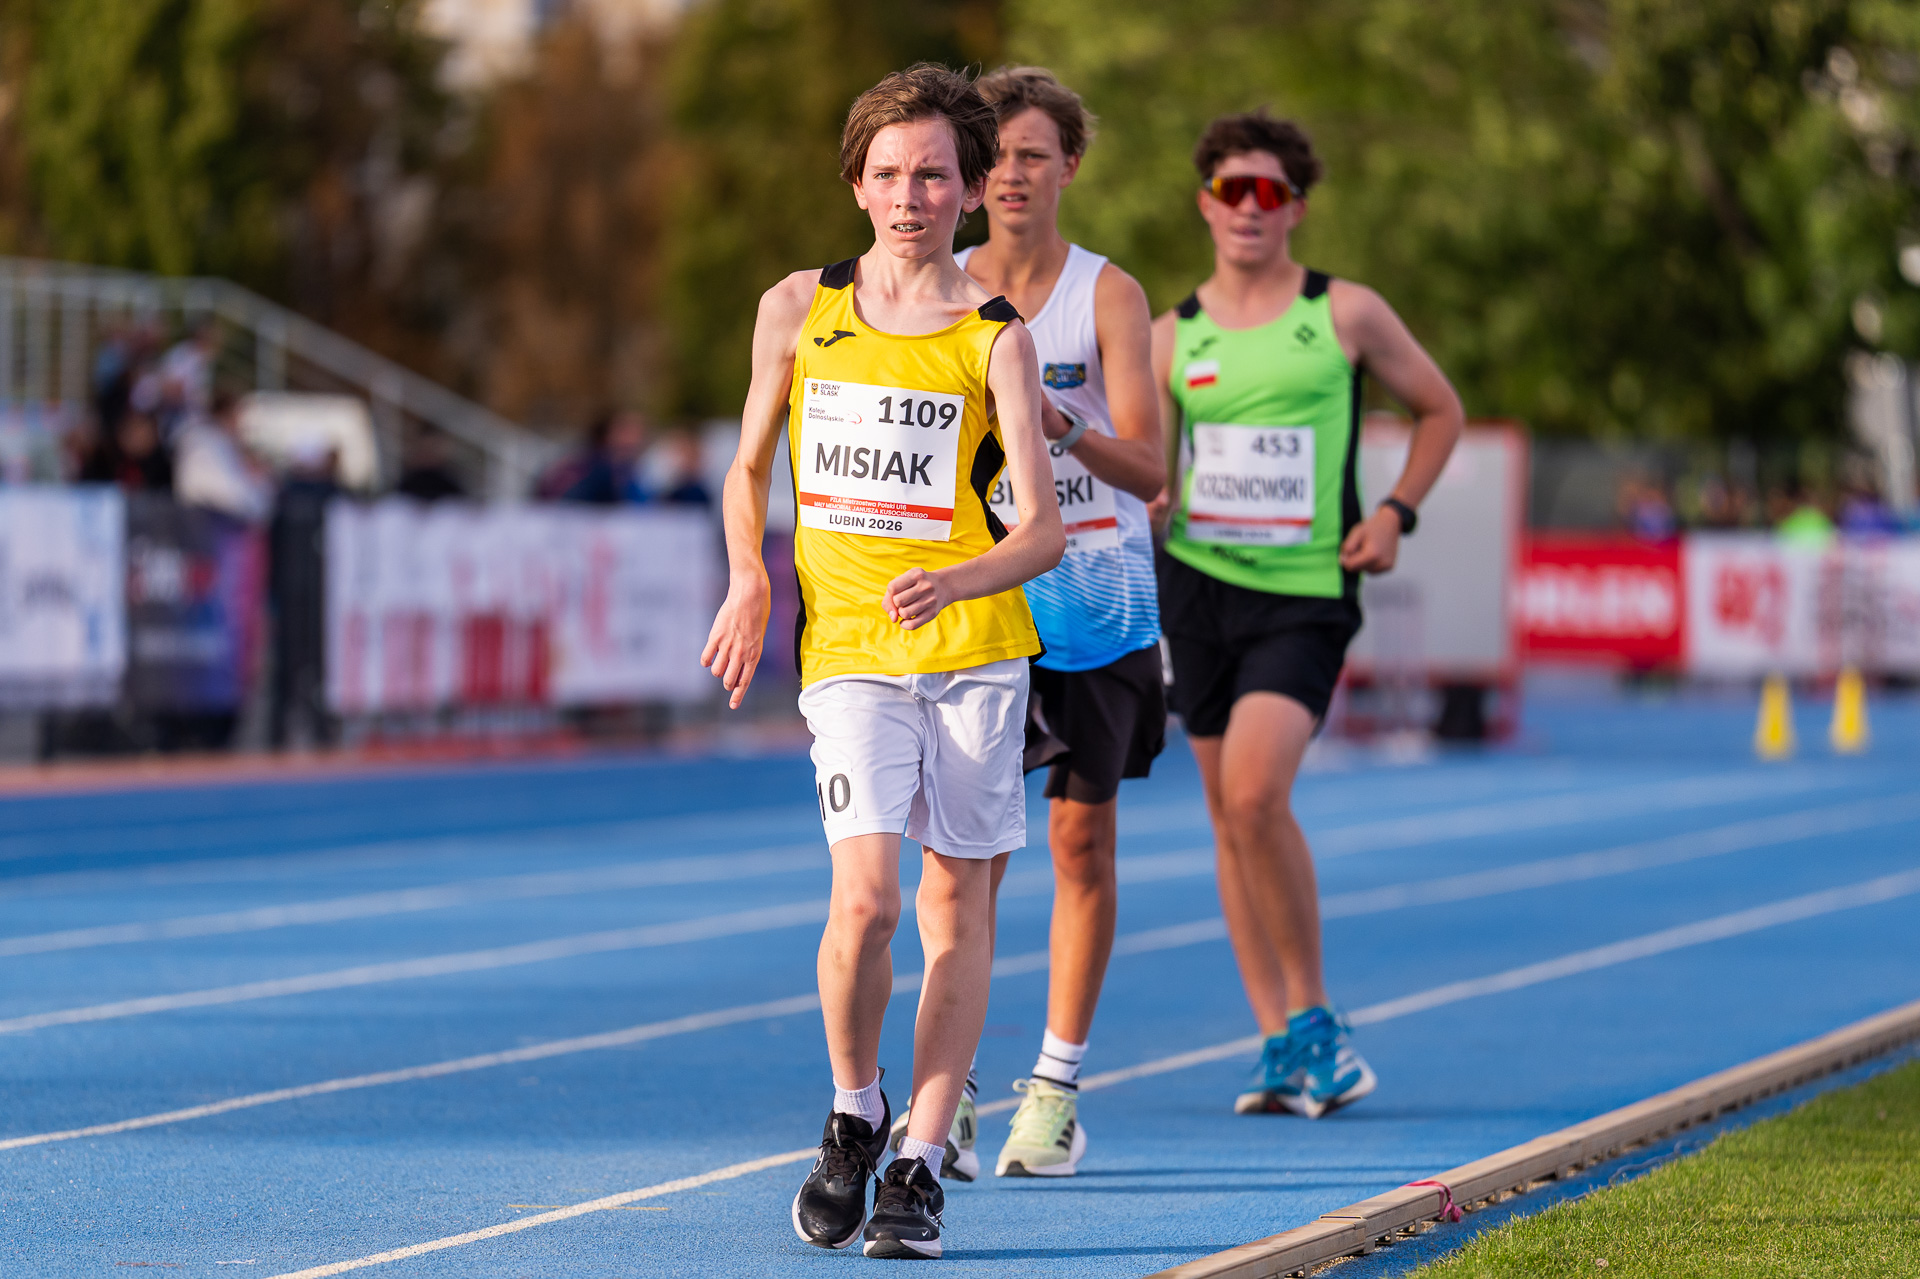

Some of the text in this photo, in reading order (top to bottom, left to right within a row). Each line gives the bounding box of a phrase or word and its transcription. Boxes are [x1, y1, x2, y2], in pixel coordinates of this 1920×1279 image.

[820, 383, 841, 391] DOLNY
[808, 406, 826, 415] Koleje
[878, 396, 958, 430] 1109
[1252, 432, 1301, 458] 453
[815, 442, 934, 487] MISIAK
[842, 497, 877, 508] Mistrzostwa
[877, 501, 896, 509] Polski
[896, 503, 907, 511] U16
[852, 506, 879, 514] JANUSZA
[829, 513, 903, 532] LUBIN 2026
